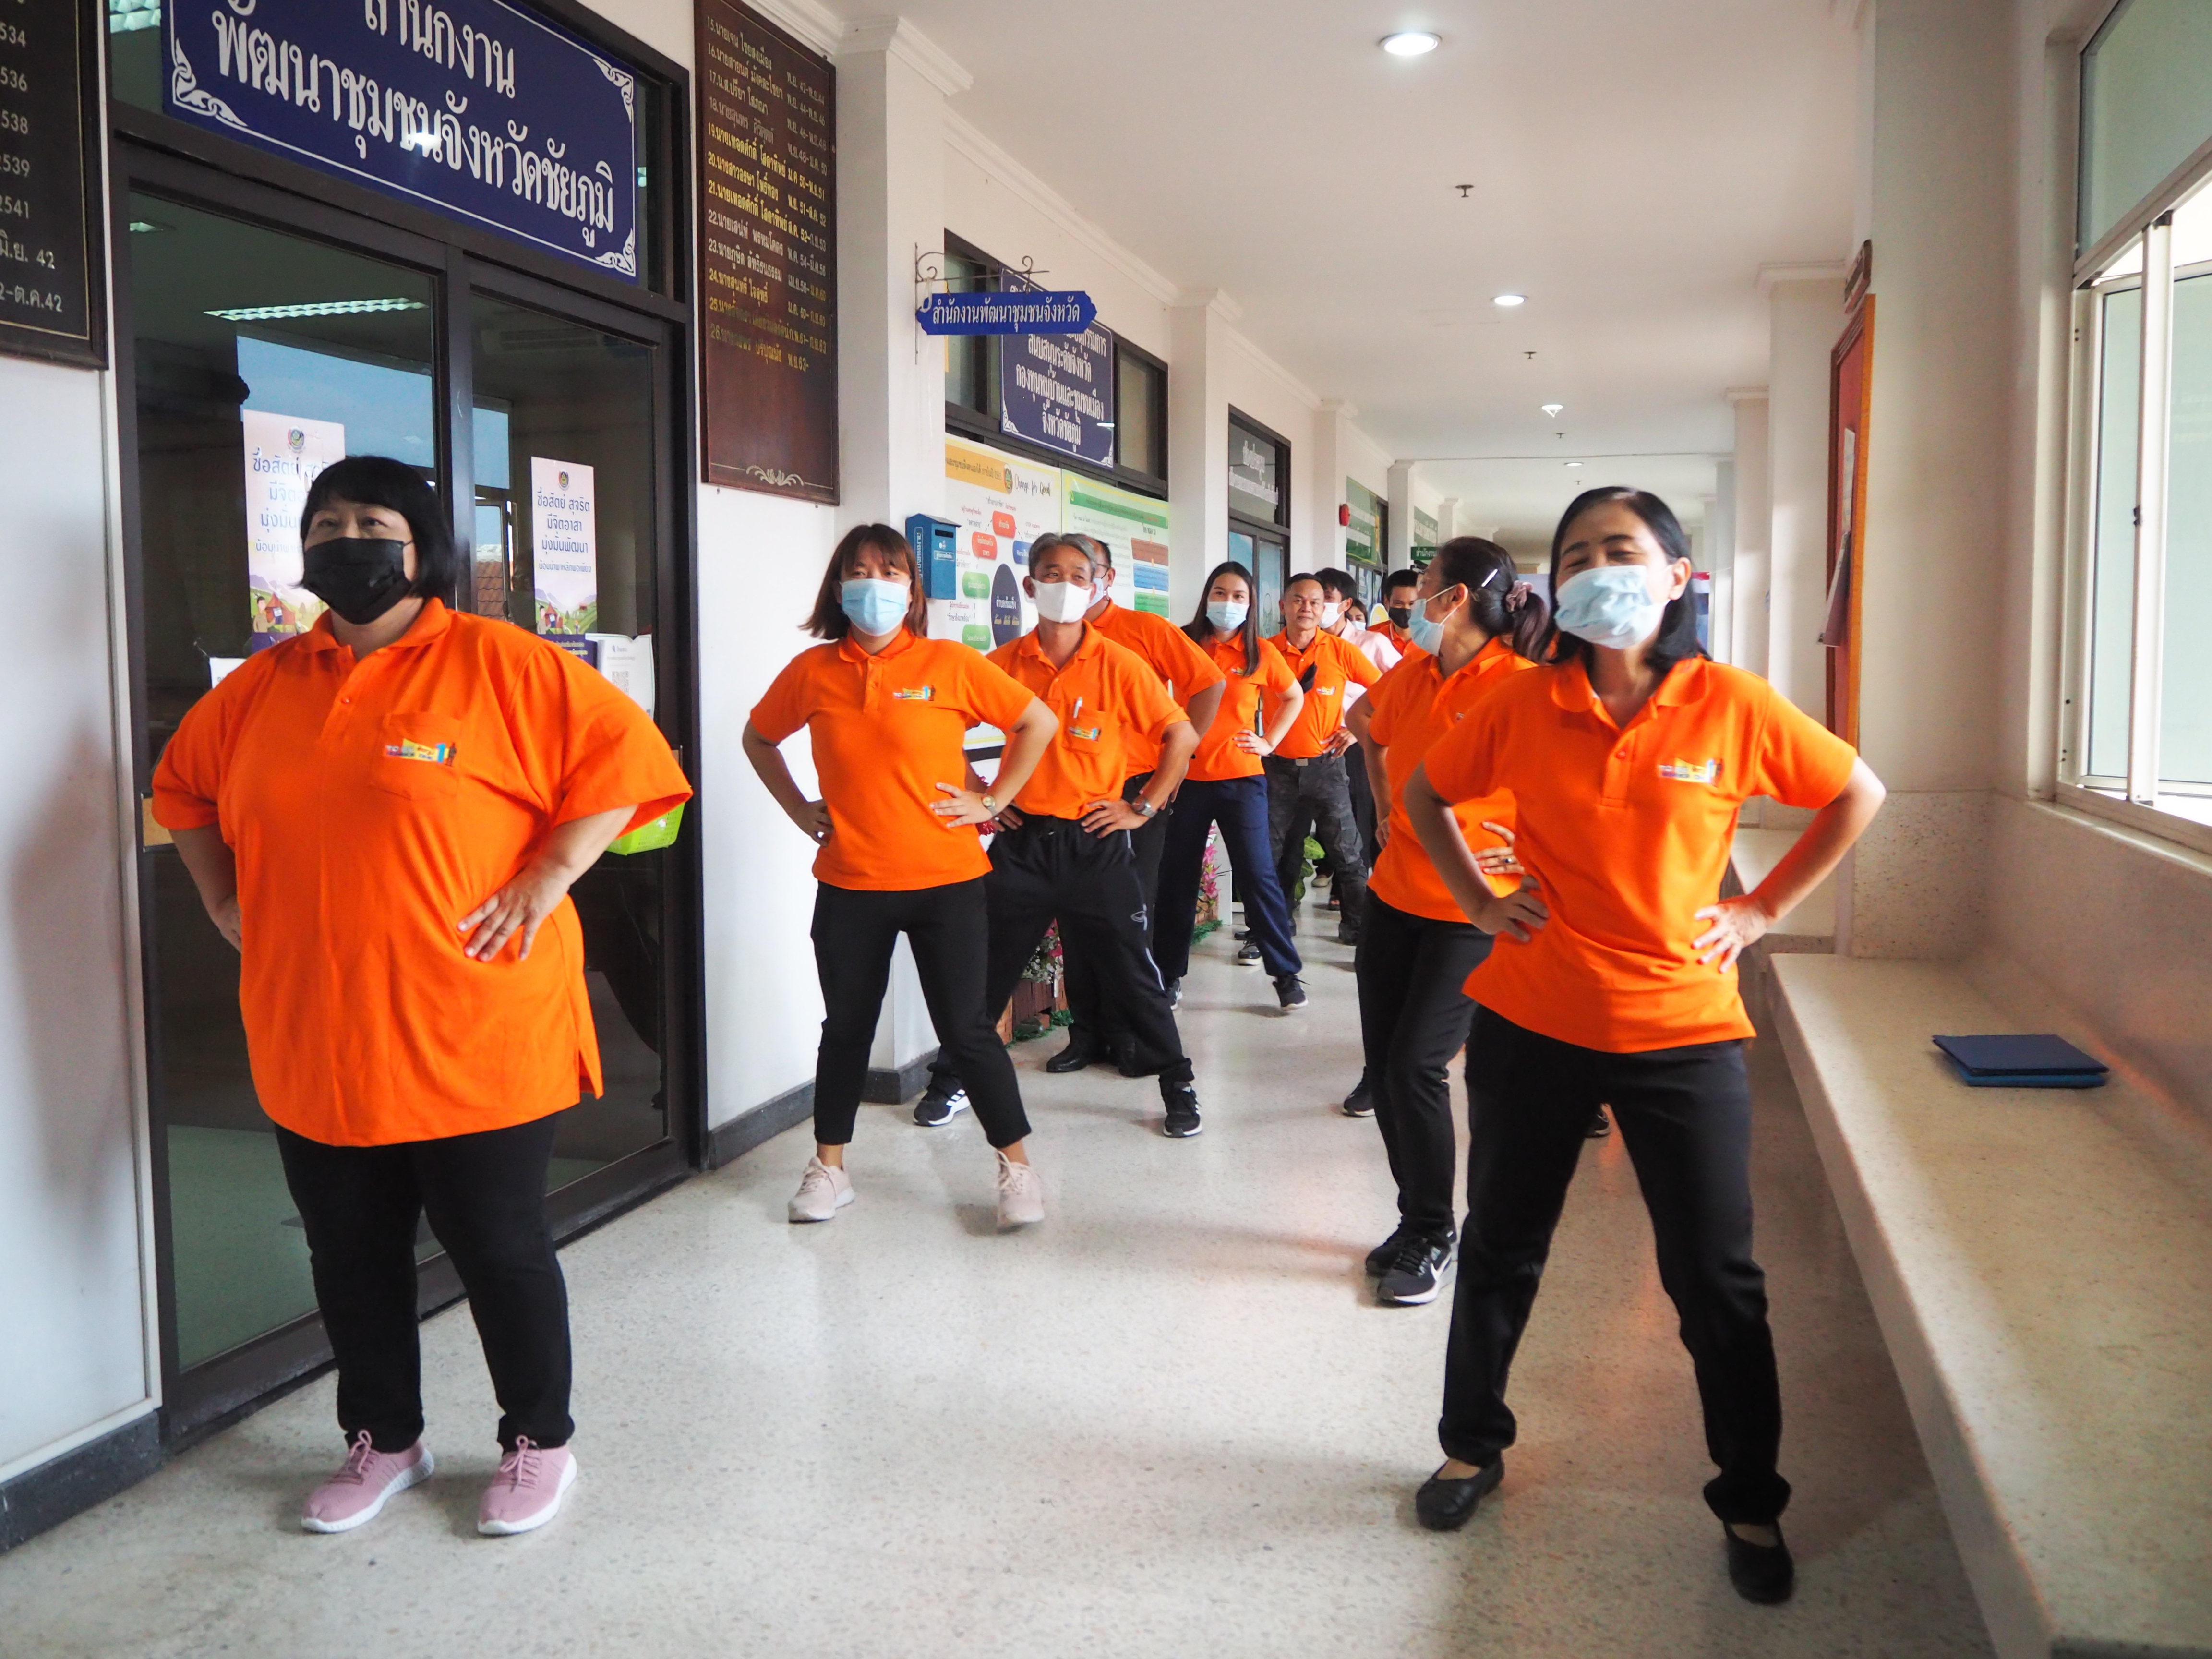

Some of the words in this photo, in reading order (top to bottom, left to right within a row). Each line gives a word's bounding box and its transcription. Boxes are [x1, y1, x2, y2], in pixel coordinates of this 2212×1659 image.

[212, 0, 613, 248] พัฒนาชุมชนจังหวัดชัยภูมิ
[0, 153, 30, 178] 539
[36, 248, 55, 270] 42
[933, 296, 1080, 333] สำนักงานพัฒนาชุมชนจังหวัด
[537, 487, 565, 509] ซื่อสัตย์
[569, 497, 590, 515] สุจริต
[547, 513, 582, 531] มีจิตอาสา
